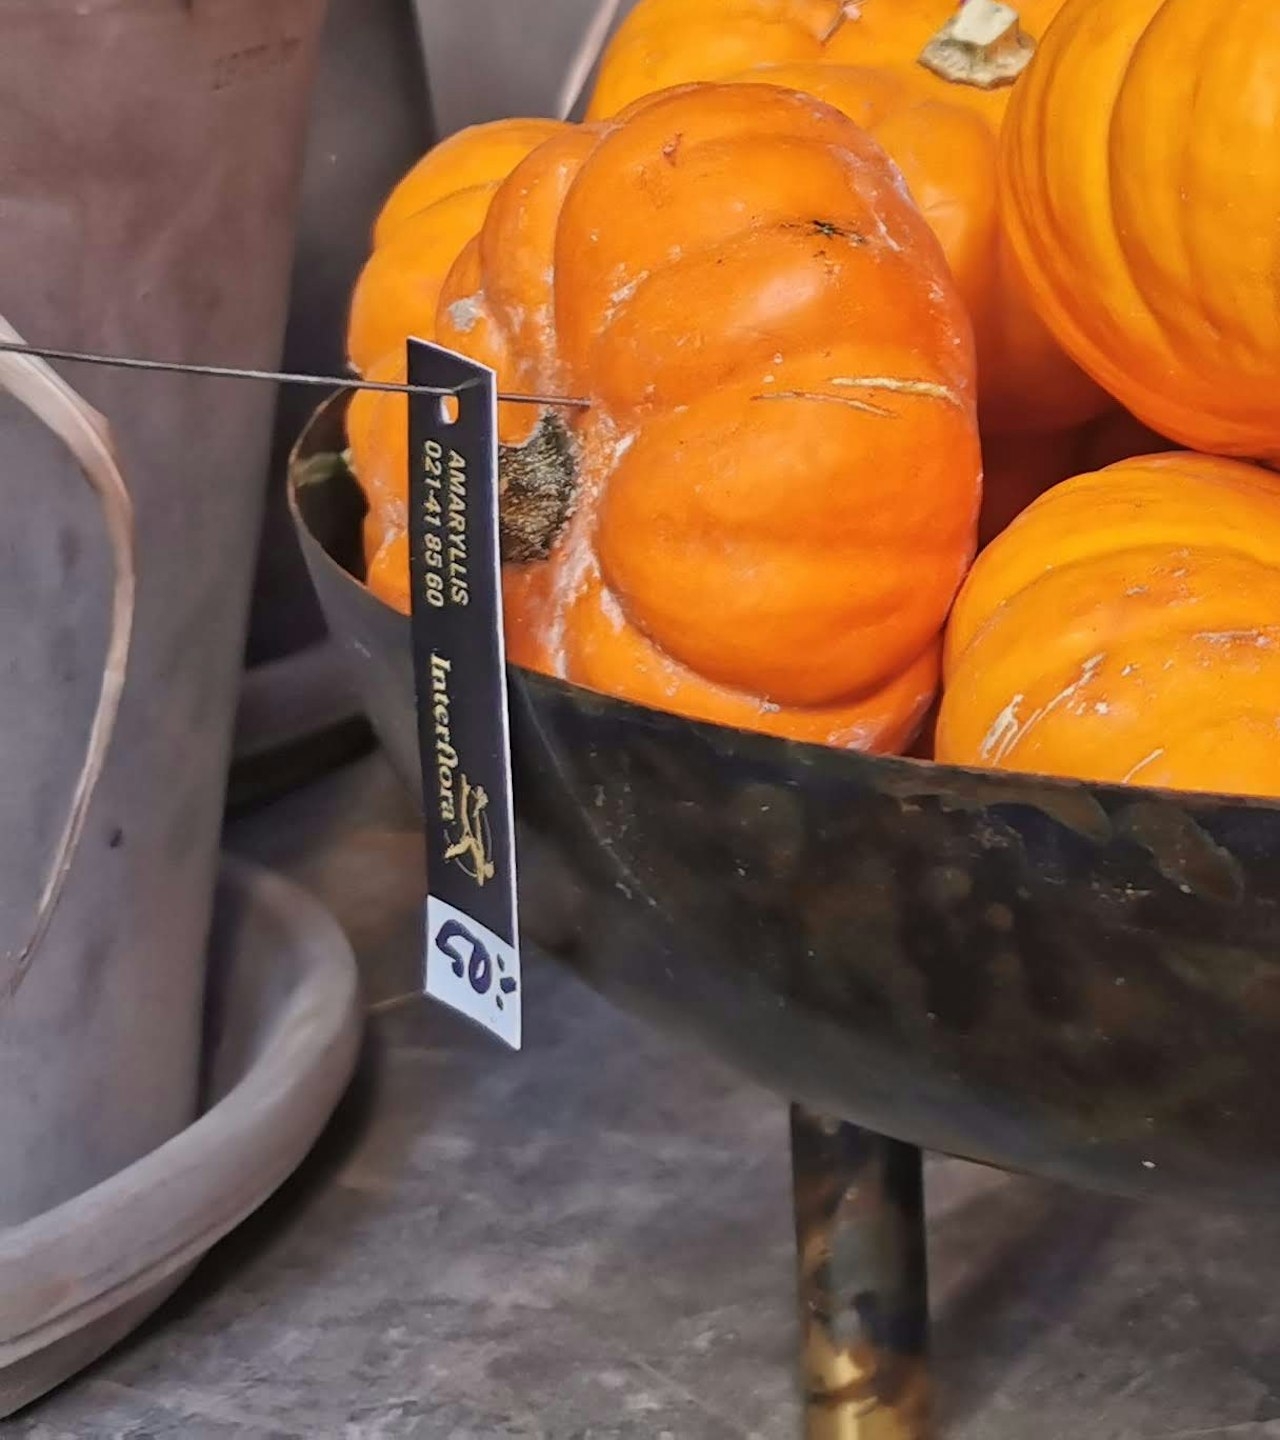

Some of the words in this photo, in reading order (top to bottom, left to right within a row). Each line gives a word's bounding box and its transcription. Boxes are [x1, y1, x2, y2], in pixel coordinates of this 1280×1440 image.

[423, 439, 443, 528] 021-41
[448, 448, 470, 608] AMARYLLIS
[424, 532, 443, 569] 85
[425, 571, 445, 609] 60
[430, 652, 459, 822] Interflora
